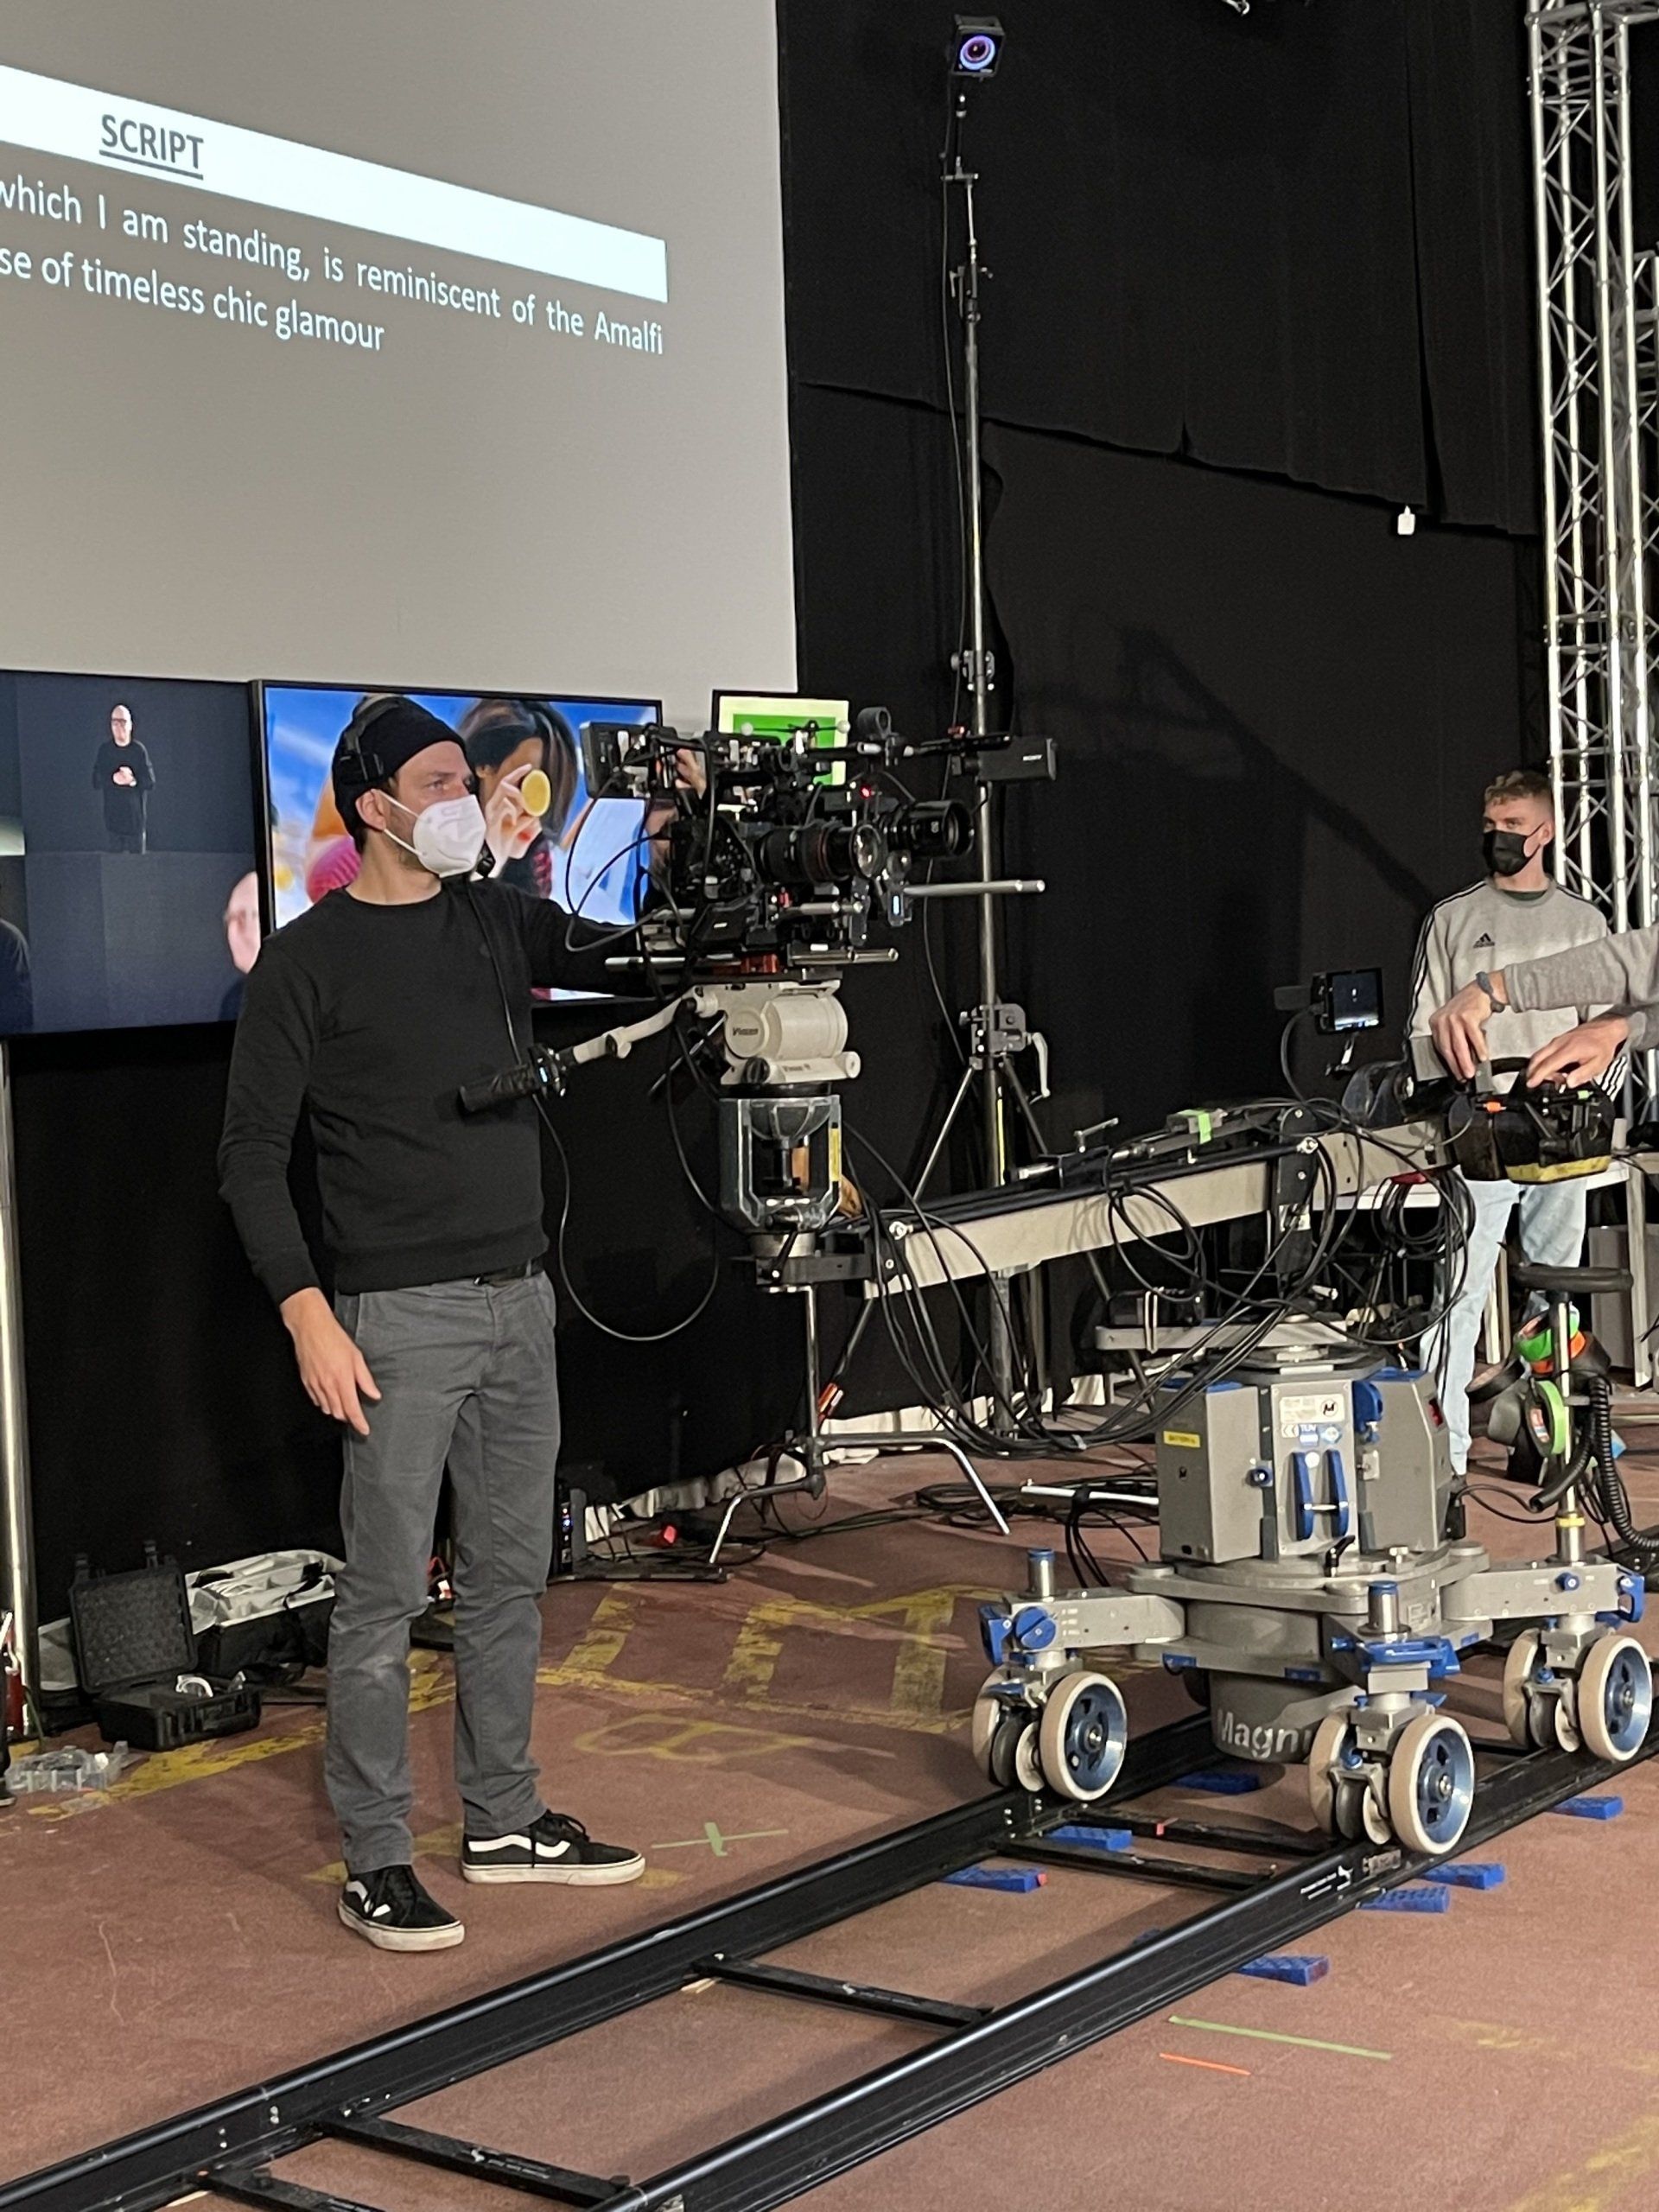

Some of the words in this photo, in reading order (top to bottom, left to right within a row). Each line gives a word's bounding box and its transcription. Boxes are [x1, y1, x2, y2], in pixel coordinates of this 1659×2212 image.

[101, 113, 205, 170] SCRIPT
[41, 251, 74, 288] of
[81, 258, 205, 315] timeless
[213, 285, 269, 327] chic
[276, 299, 385, 353] glamour
[99, 194, 106, 230] I
[123, 209, 168, 244] am
[183, 219, 309, 282] standing,
[324, 246, 344, 282] is
[357, 263, 501, 318] reminiscent
[512, 293, 536, 326] of
[545, 300, 584, 337] the
[594, 310, 663, 355] Amalfi
